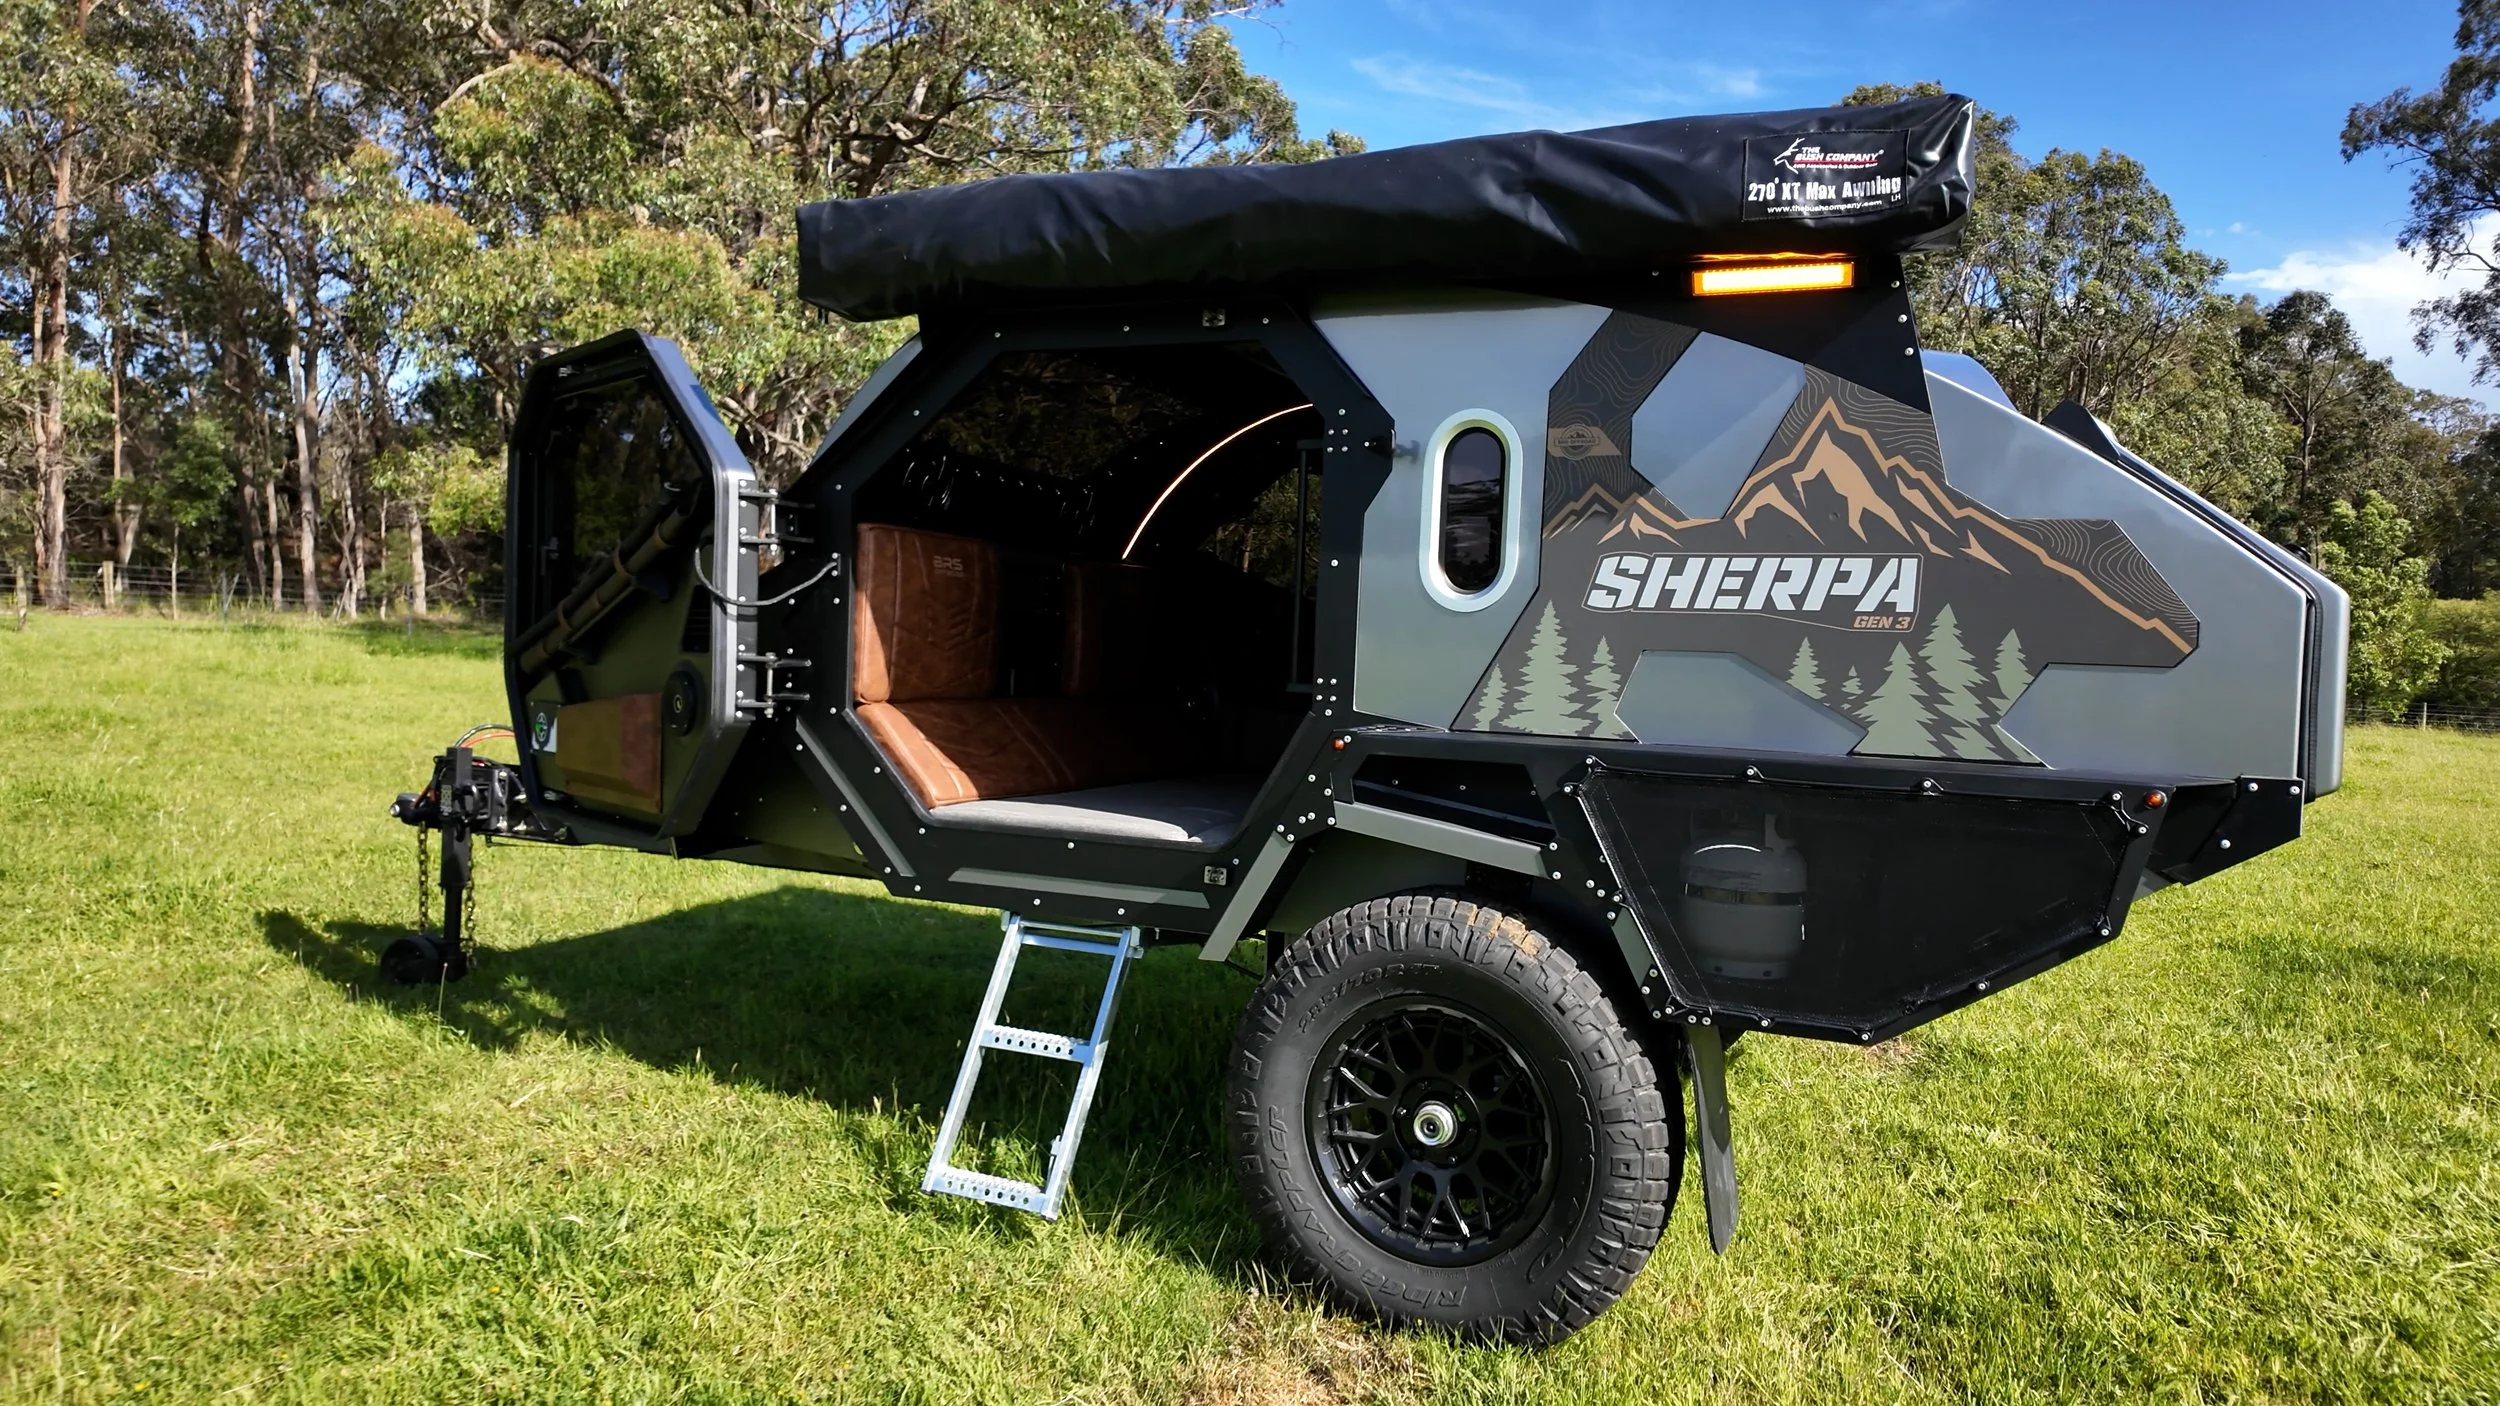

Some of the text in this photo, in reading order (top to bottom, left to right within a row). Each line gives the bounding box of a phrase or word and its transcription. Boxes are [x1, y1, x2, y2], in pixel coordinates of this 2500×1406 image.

[1794, 152, 1879, 161] BUSH COMPANY
[1801, 146, 1821, 154] THE
[1782, 182, 1801, 201] XT
[1806, 181, 1836, 201] Max
[1842, 175, 1902, 198] Awning
[1891, 193, 1901, 202] LH
[1767, 200, 1883, 213] www.thebushcompany.com
[1587, 556, 1919, 612] SHERPA
[1853, 616, 1912, 630] GEN 3
[1268, 1103, 1362, 1273] GRAPPLER
[1360, 1269, 1468, 1309] RIDGE
